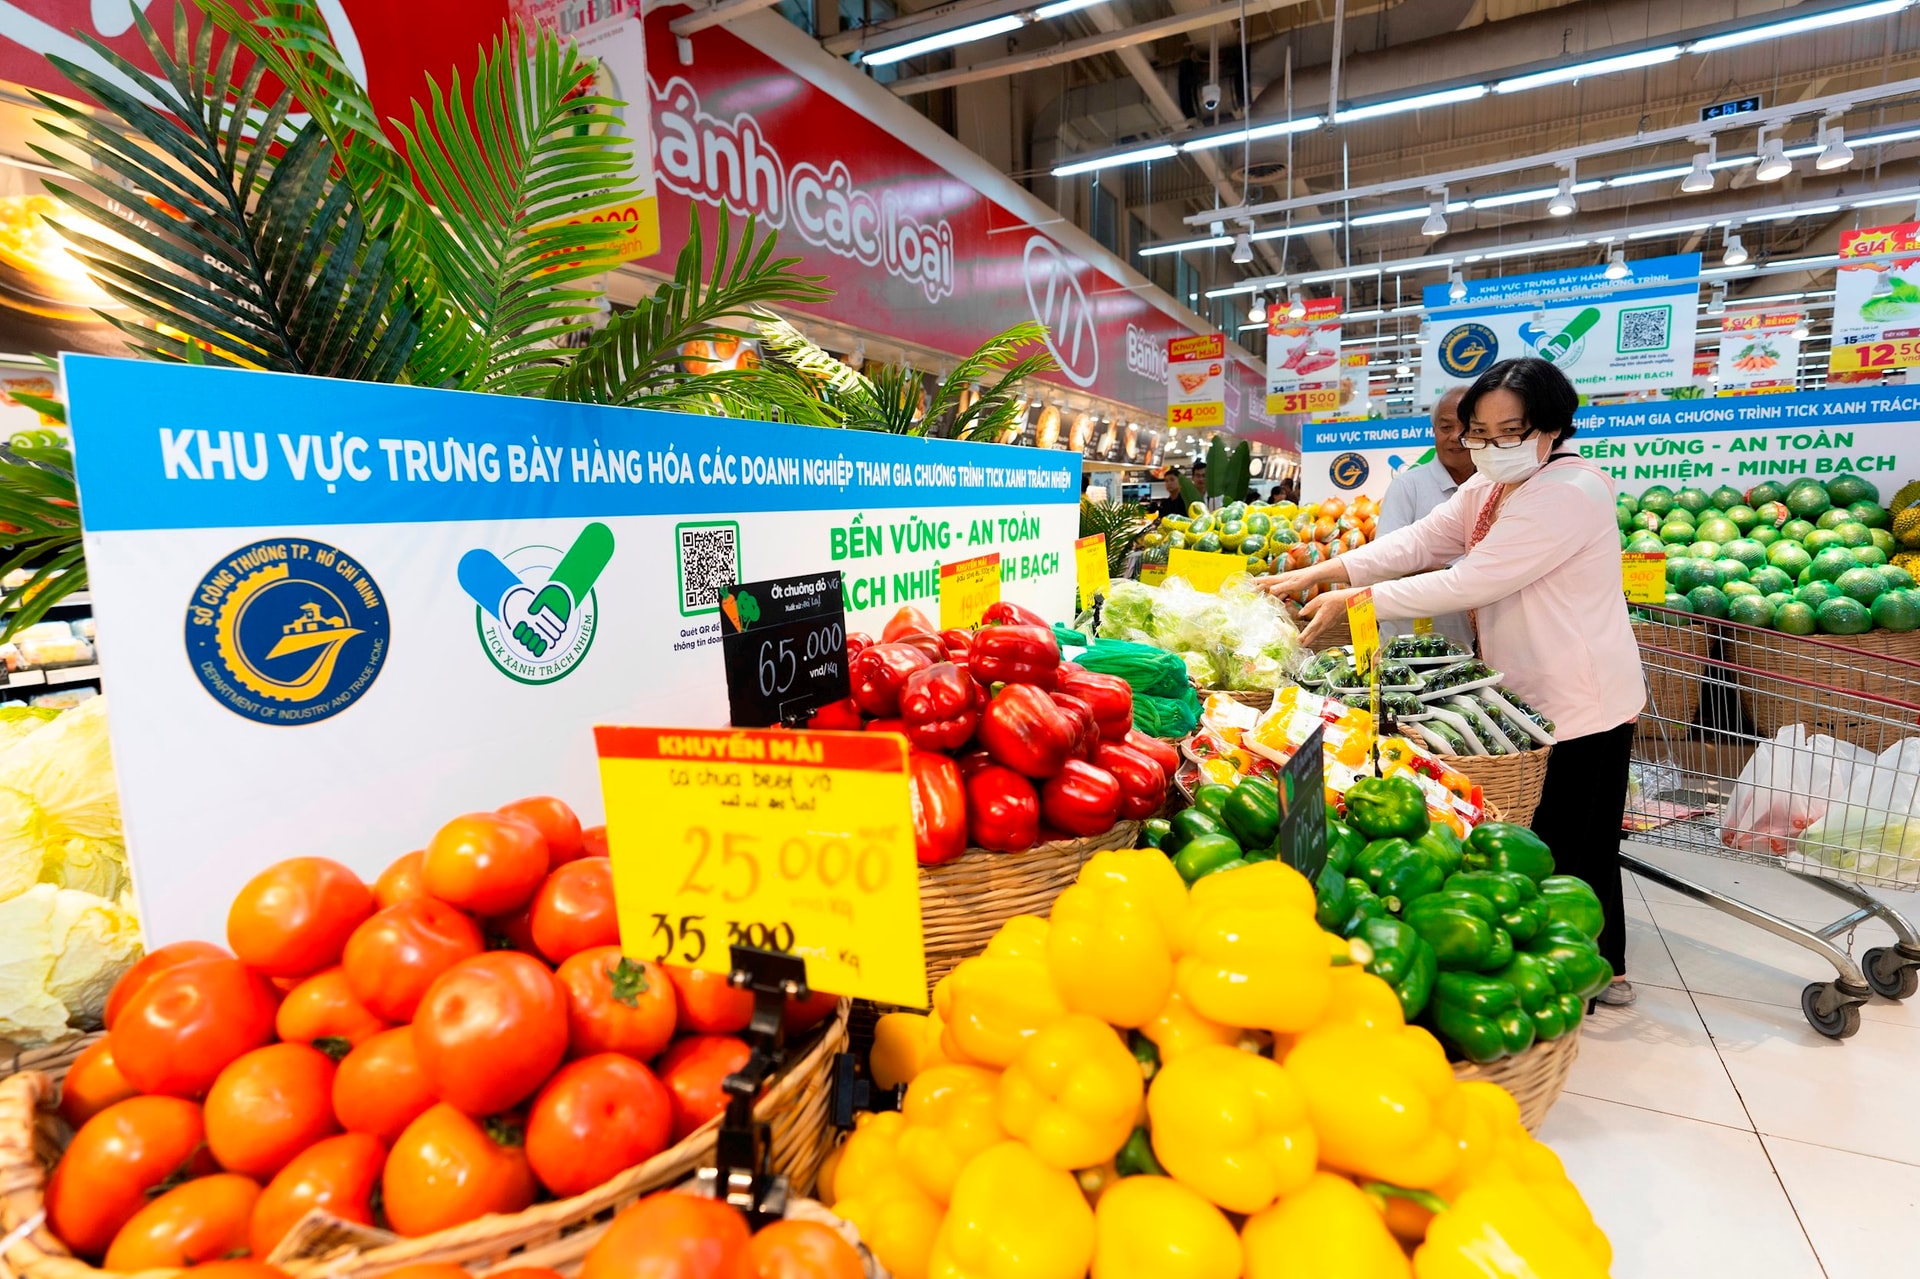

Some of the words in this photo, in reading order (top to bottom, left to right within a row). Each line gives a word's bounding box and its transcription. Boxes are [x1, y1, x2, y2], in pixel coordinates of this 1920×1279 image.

[658, 88, 782, 220] ánh
[793, 170, 878, 259] các
[885, 191, 951, 297] loại
[1480, 284, 1499, 294] KHU
[1127, 327, 1159, 378] Bánh
[1615, 373, 1641, 382] MINH
[1608, 414, 1646, 428] THAM
[1648, 412, 1671, 425] GIA
[1675, 408, 1735, 424] CHƯƠNG
[1738, 404, 1781, 420] TRÌNH
[1785, 402, 1818, 417] TICK
[1822, 400, 1867, 416] XANH
[1870, 395, 1920, 413] TRÁCH
[1316, 432, 1337, 444] KHU
[1340, 430, 1361, 445] VỰC
[1363, 428, 1399, 441] TRƯNG
[1401, 425, 1423, 439] BÀY
[1580, 437, 1626, 458] BỀN
[1633, 437, 1704, 457] VỮNG
[1729, 436, 1767, 453] AN
[1776, 428, 1854, 450] TOÀN
[159, 428, 268, 480] KHU
[278, 431, 371, 493] VỰC
[379, 437, 499, 482] TRƯNG
[507, 435, 564, 482] BÀY
[571, 438, 643, 484] HÀNG
[647, 442, 695, 484] HÓA
[699, 445, 738, 485] CÁC
[741, 455, 799, 486] DOANH
[802, 453, 853, 493] NGHIỆP
[856, 461, 890, 487] THAM
[893, 463, 912, 487] GIA
[914, 462, 957, 488] CHƯƠNG
[958, 460, 984, 488] TRÌNH
[986, 467, 1004, 489] TICK
[1005, 468, 1027, 489] XANH
[1028, 465, 1051, 489] TRÁCH
[1051, 466, 1071, 493] NHIỆM
[1634, 460, 1713, 483] NHIỆM
[1737, 459, 1806, 476] MINH
[1815, 455, 1896, 476] BẠCH
[830, 513, 882, 560] BỀN
[890, 516, 950, 554] VỮNG
[968, 520, 993, 546] AN
[998, 511, 1040, 542] TOÀN
[229, 544, 288, 575] THƯƠNG
[290, 543, 312, 560] TP.
[315, 548, 339, 567] HỒ
[336, 560, 362, 582] CHÍ
[841, 571, 886, 612] ÁCH
[893, 560, 941, 603] NHIỆ
[1000, 557, 1016, 583] NH
[1021, 551, 1059, 584] BẠCH
[201, 568, 236, 605] CÔNG
[353, 577, 380, 609] MINH
[190, 604, 215, 626] SỞ
[699, 625, 710, 634] QR
[486, 626, 505, 659] TICK
[503, 655, 536, 677] XANH
[538, 653, 575, 677] TRÁCH
[573, 614, 593, 654] NHIỆM
[673, 640, 696, 651] thông
[200, 660, 260, 718] DEPARTMENT
[260, 706, 276, 718] OF
[278, 702, 330, 720] INDUSTRY
[331, 691, 351, 708] AND
[350, 665, 375, 693] TRADE
[371, 637, 384, 666] HCMC
[658, 733, 767, 759] KHUYẾN
